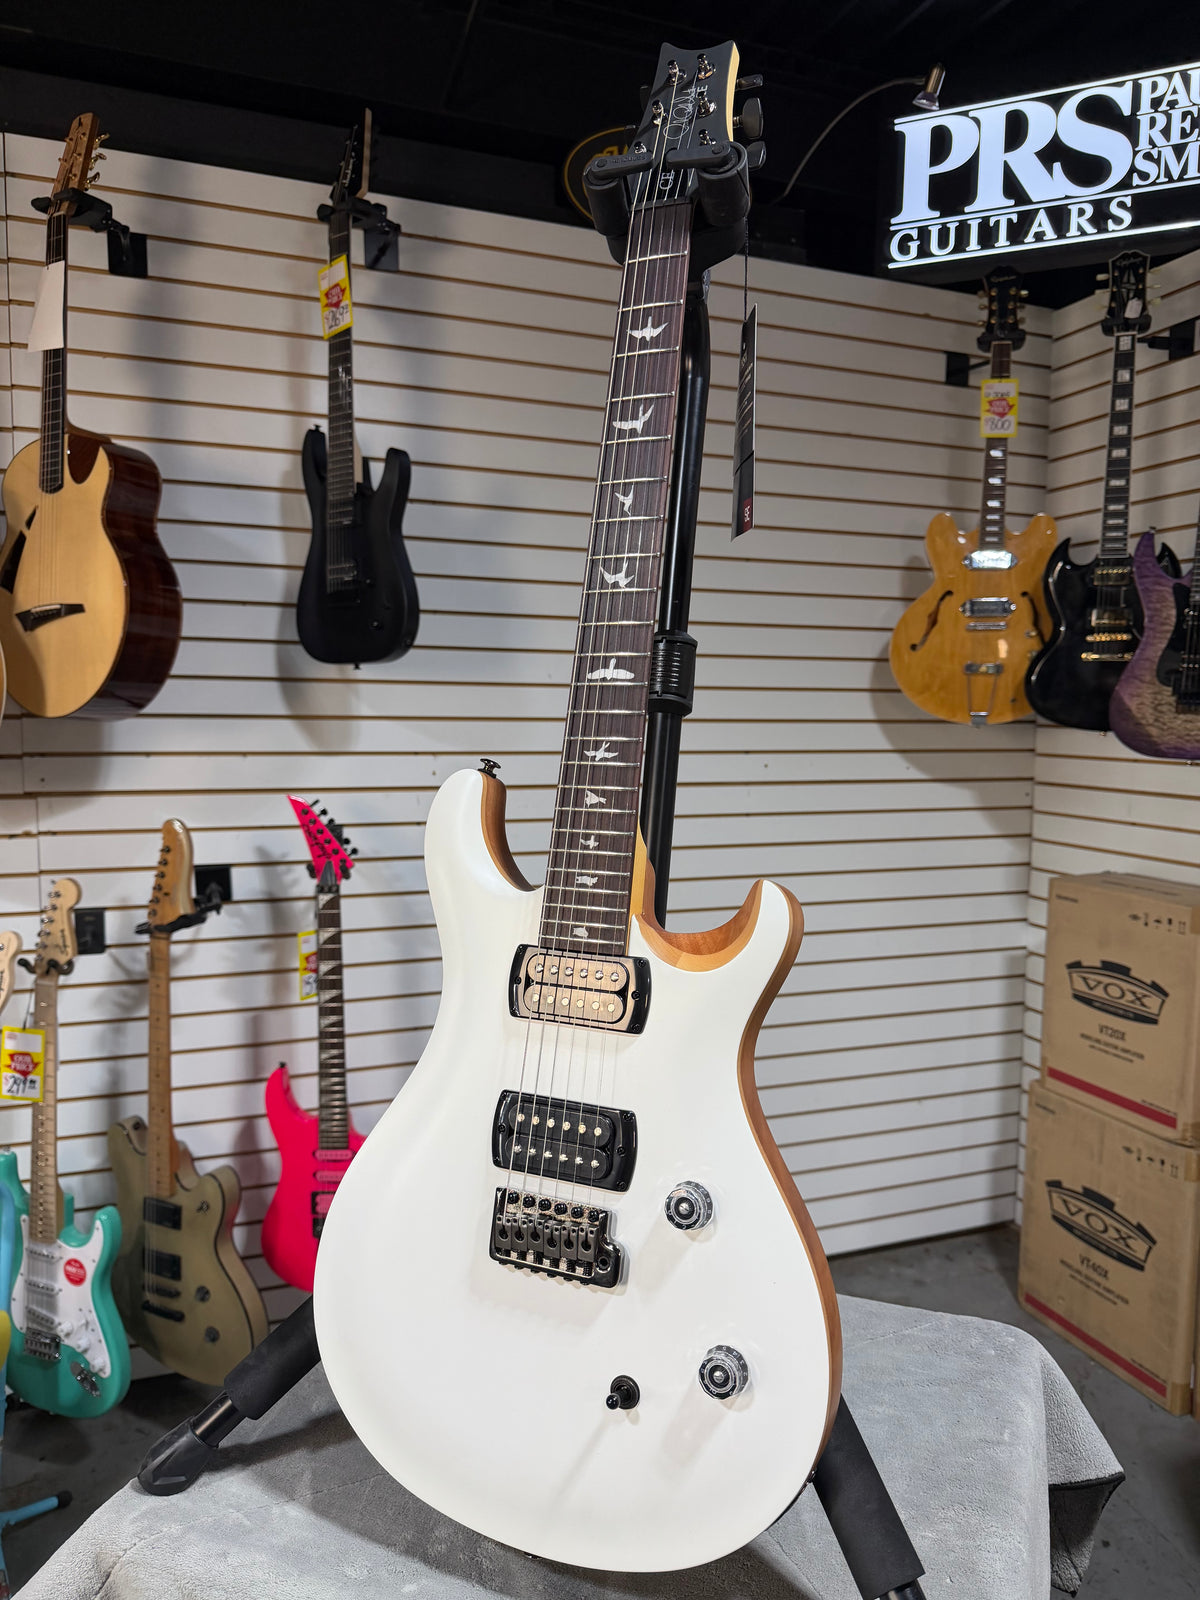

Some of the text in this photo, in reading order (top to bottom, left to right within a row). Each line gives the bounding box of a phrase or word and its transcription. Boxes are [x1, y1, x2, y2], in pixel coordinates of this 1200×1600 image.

[890, 80, 1133, 224] PRS
[889, 195, 1132, 262] GUITARS
[1077, 975, 1152, 1010] VOX
[1057, 1195, 1138, 1253] VOX
